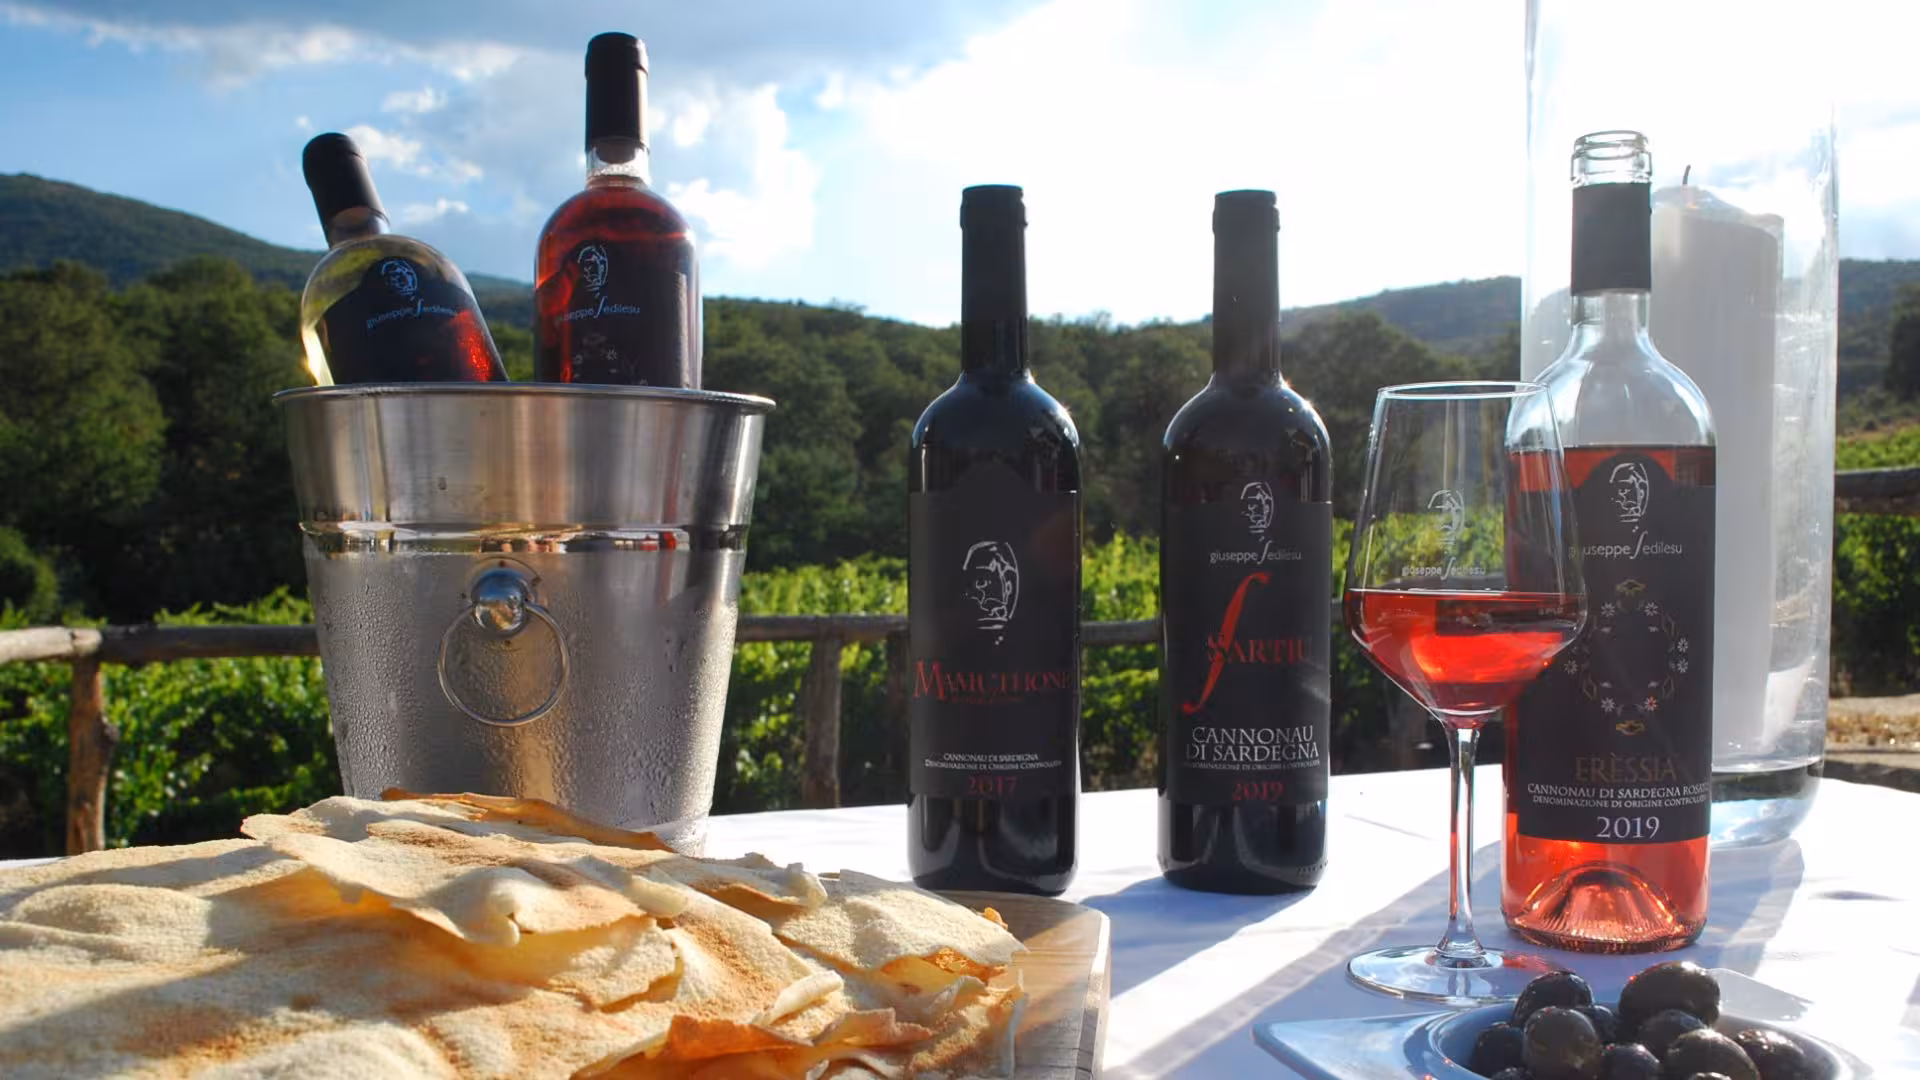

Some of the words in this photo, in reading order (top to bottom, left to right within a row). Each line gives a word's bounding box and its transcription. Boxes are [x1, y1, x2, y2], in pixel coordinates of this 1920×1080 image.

[1192, 725, 1313, 745] CANNONAU
[1186, 743, 1206, 760] DI
[1213, 742, 1319, 762] SARDEGNA
[1528, 783, 1596, 799] CANNONAU
[1600, 788, 1614, 799] DI
[1618, 786, 1681, 799] SARDEGNA
[1533, 795, 1609, 809] DENOMINAZIONE
[1611, 800, 1623, 808] DI
[1626, 799, 1663, 808] ORIGINE
[1596, 815, 1660, 839] 2019
